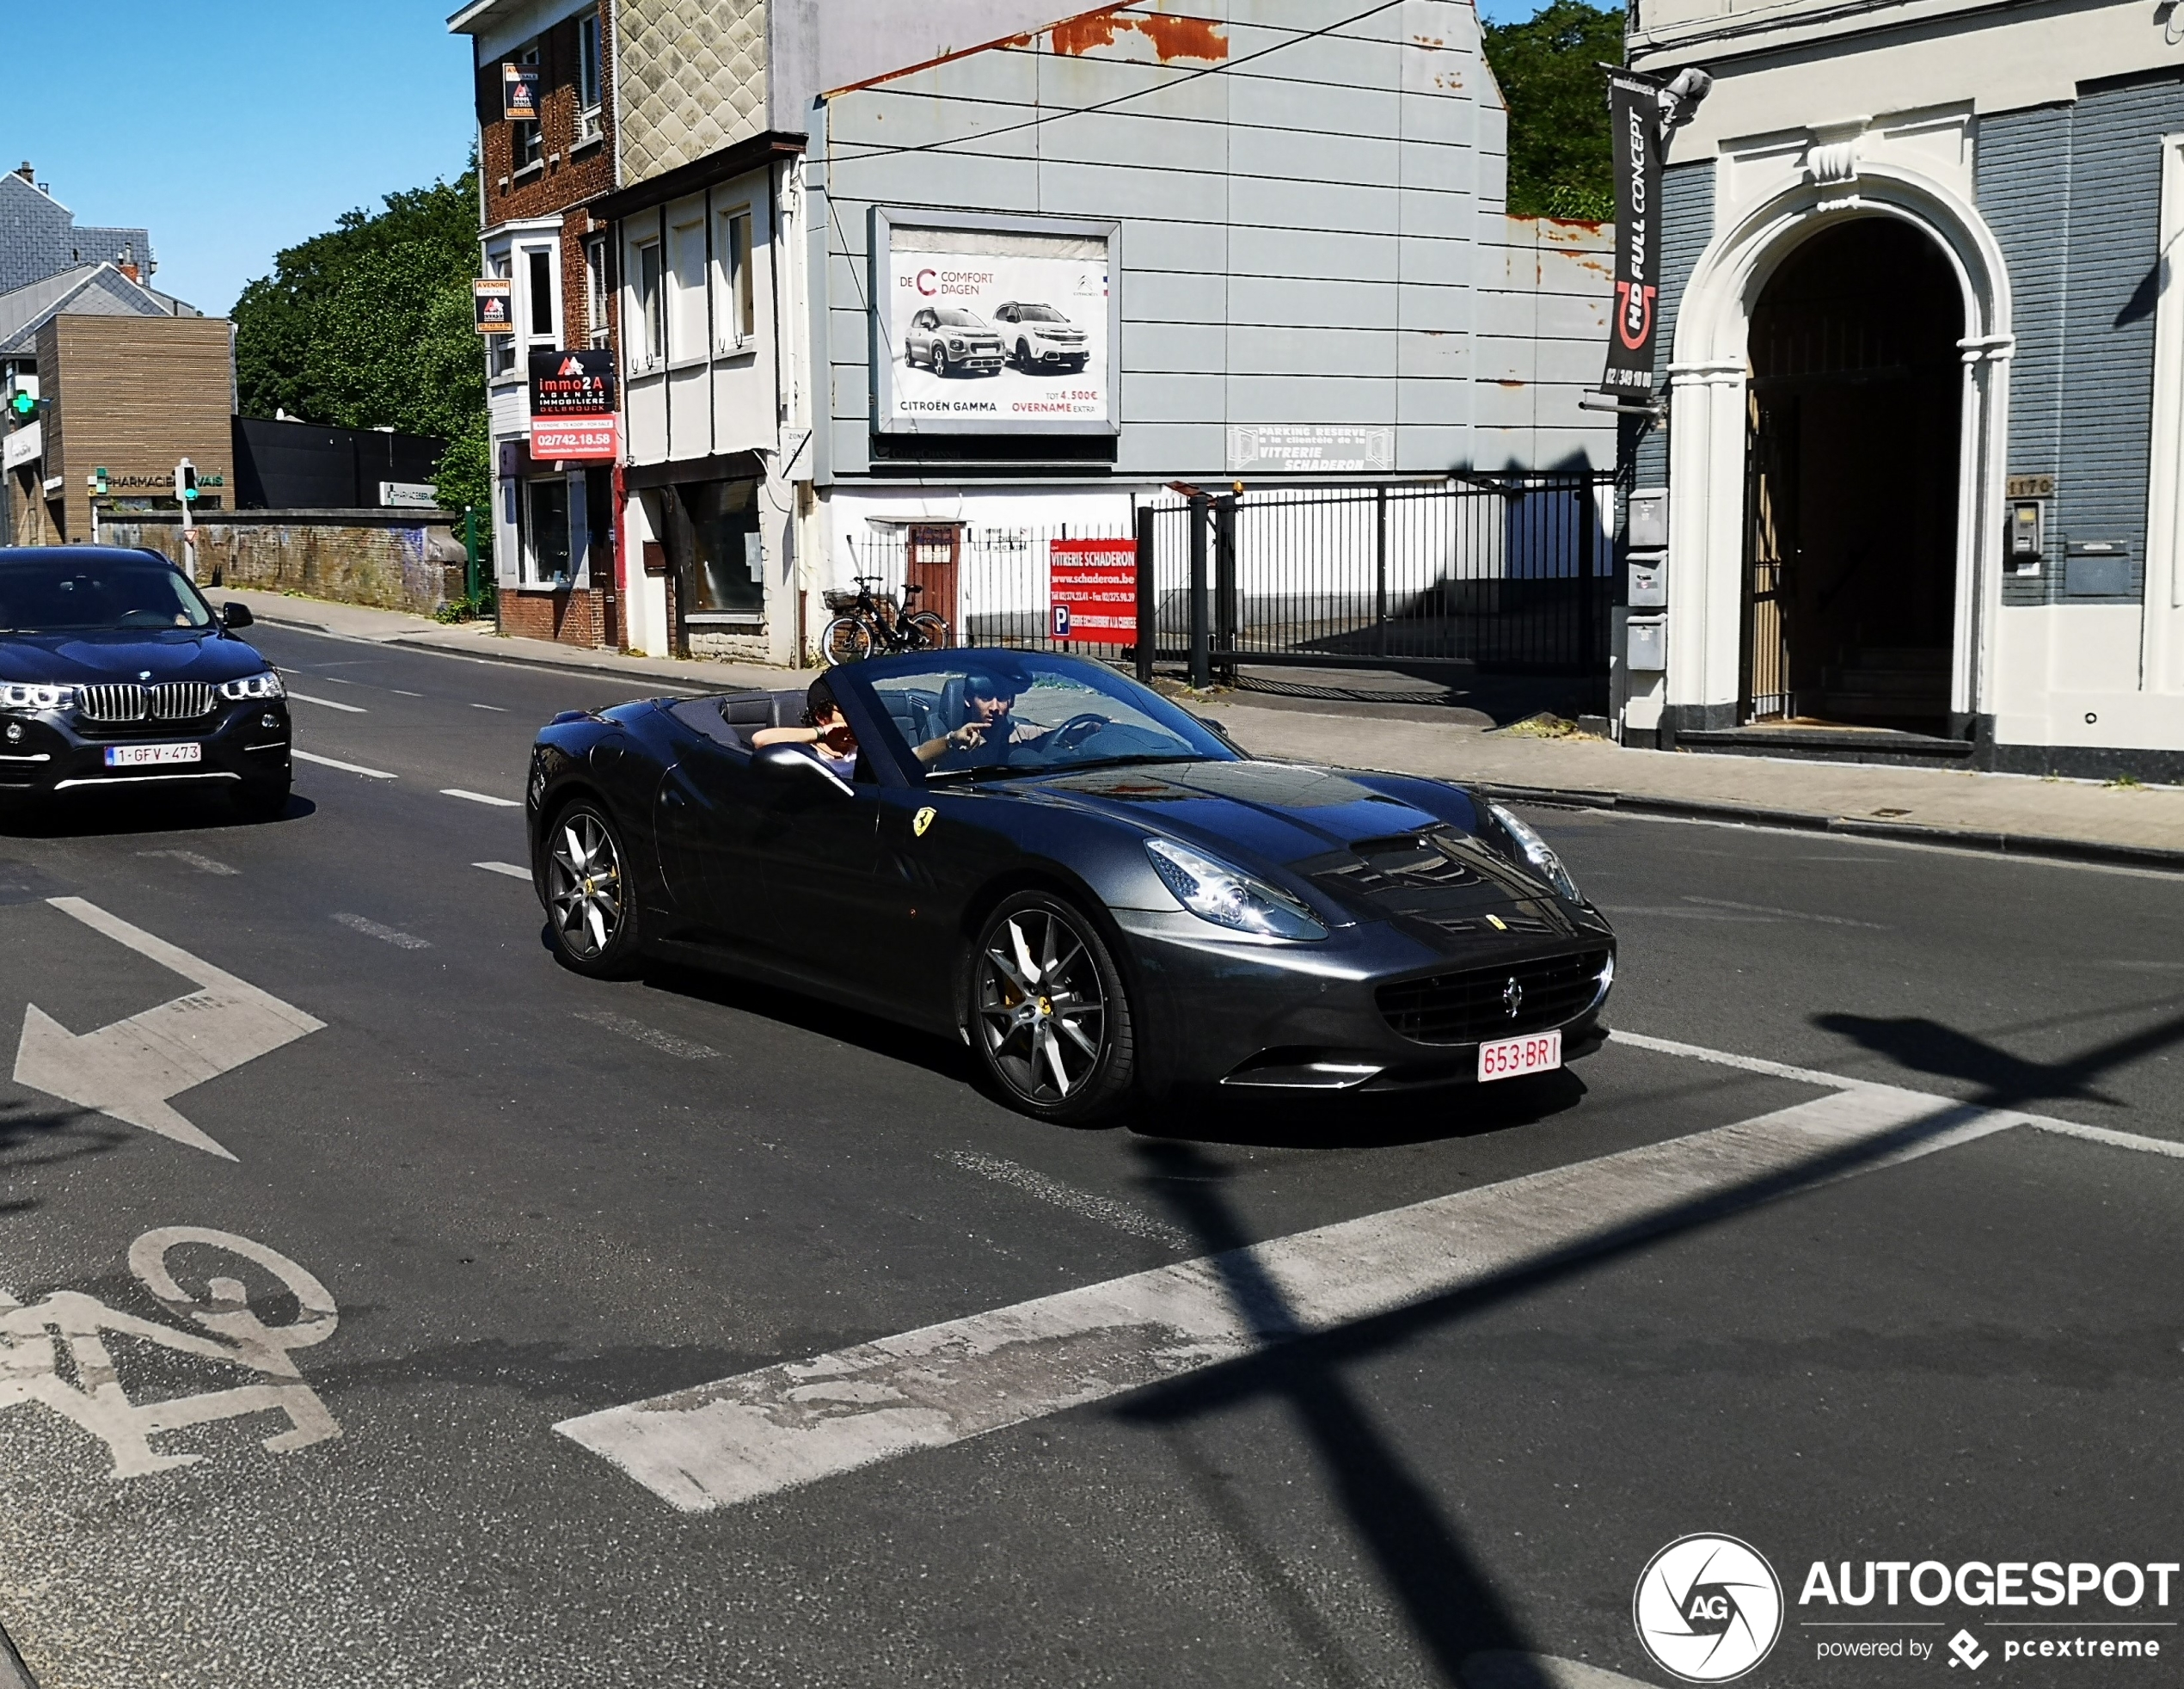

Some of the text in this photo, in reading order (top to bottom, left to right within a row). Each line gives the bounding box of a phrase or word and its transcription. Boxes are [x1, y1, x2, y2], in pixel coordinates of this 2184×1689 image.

[1628, 107, 1646, 330] HD FULL CONCEPT
[899, 276, 913, 287] DE
[941, 272, 994, 283] COMFORT
[941, 284, 979, 295] DAGEN
[539, 377, 604, 390] immo2A
[1060, 390, 1098, 400] 4.500€
[899, 401, 951, 412] CITROËN
[954, 402, 997, 412] GAMMA
[1011, 402, 1071, 413] OVERNAME
[1258, 427, 1366, 437] PARKING RESERVE
[537, 433, 610, 446] 02/742.18.58
[1259, 446, 1323, 458] VITRERIE
[1284, 459, 1365, 471] SCHADERON
[2009, 479, 2050, 495] 1170
[1051, 551, 1135, 567] VITRERIE SCHADERON
[1051, 572, 1135, 584] www.schaderon.be
[1055, 607, 1067, 632] P
